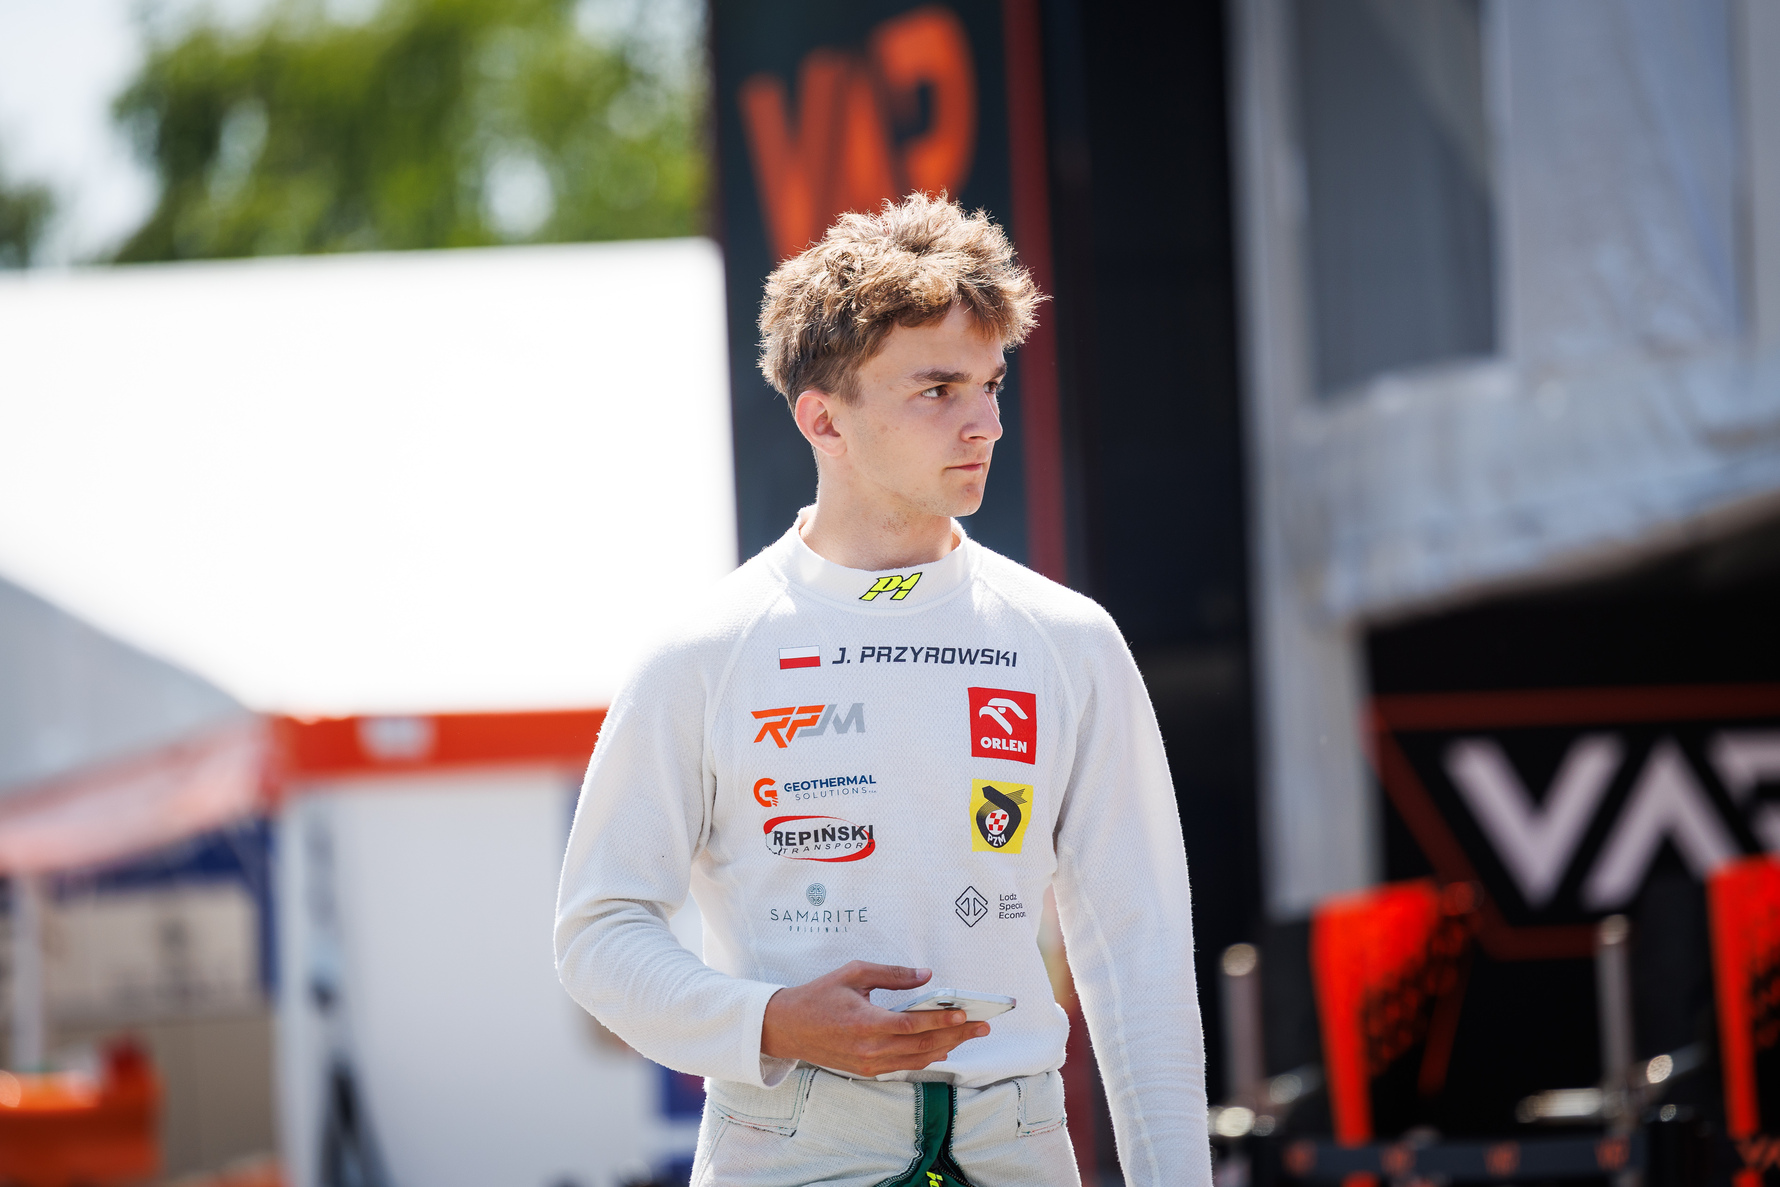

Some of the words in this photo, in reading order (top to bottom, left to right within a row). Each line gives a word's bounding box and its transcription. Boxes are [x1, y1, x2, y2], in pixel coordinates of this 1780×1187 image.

[859, 571, 923, 601] P1
[831, 647, 851, 665] J.
[860, 646, 1018, 668] PRZYROWSKI
[751, 702, 866, 748] RPM
[980, 736, 1028, 753] ORLEN
[783, 774, 877, 792] GEOTHERMAL
[795, 786, 868, 801] SOLUTIONS
[773, 824, 874, 847] REPIŃSKI
[987, 833, 1007, 847] PZM
[782, 841, 874, 855] TRANSPORT
[770, 906, 868, 923] SAMARITÉ
